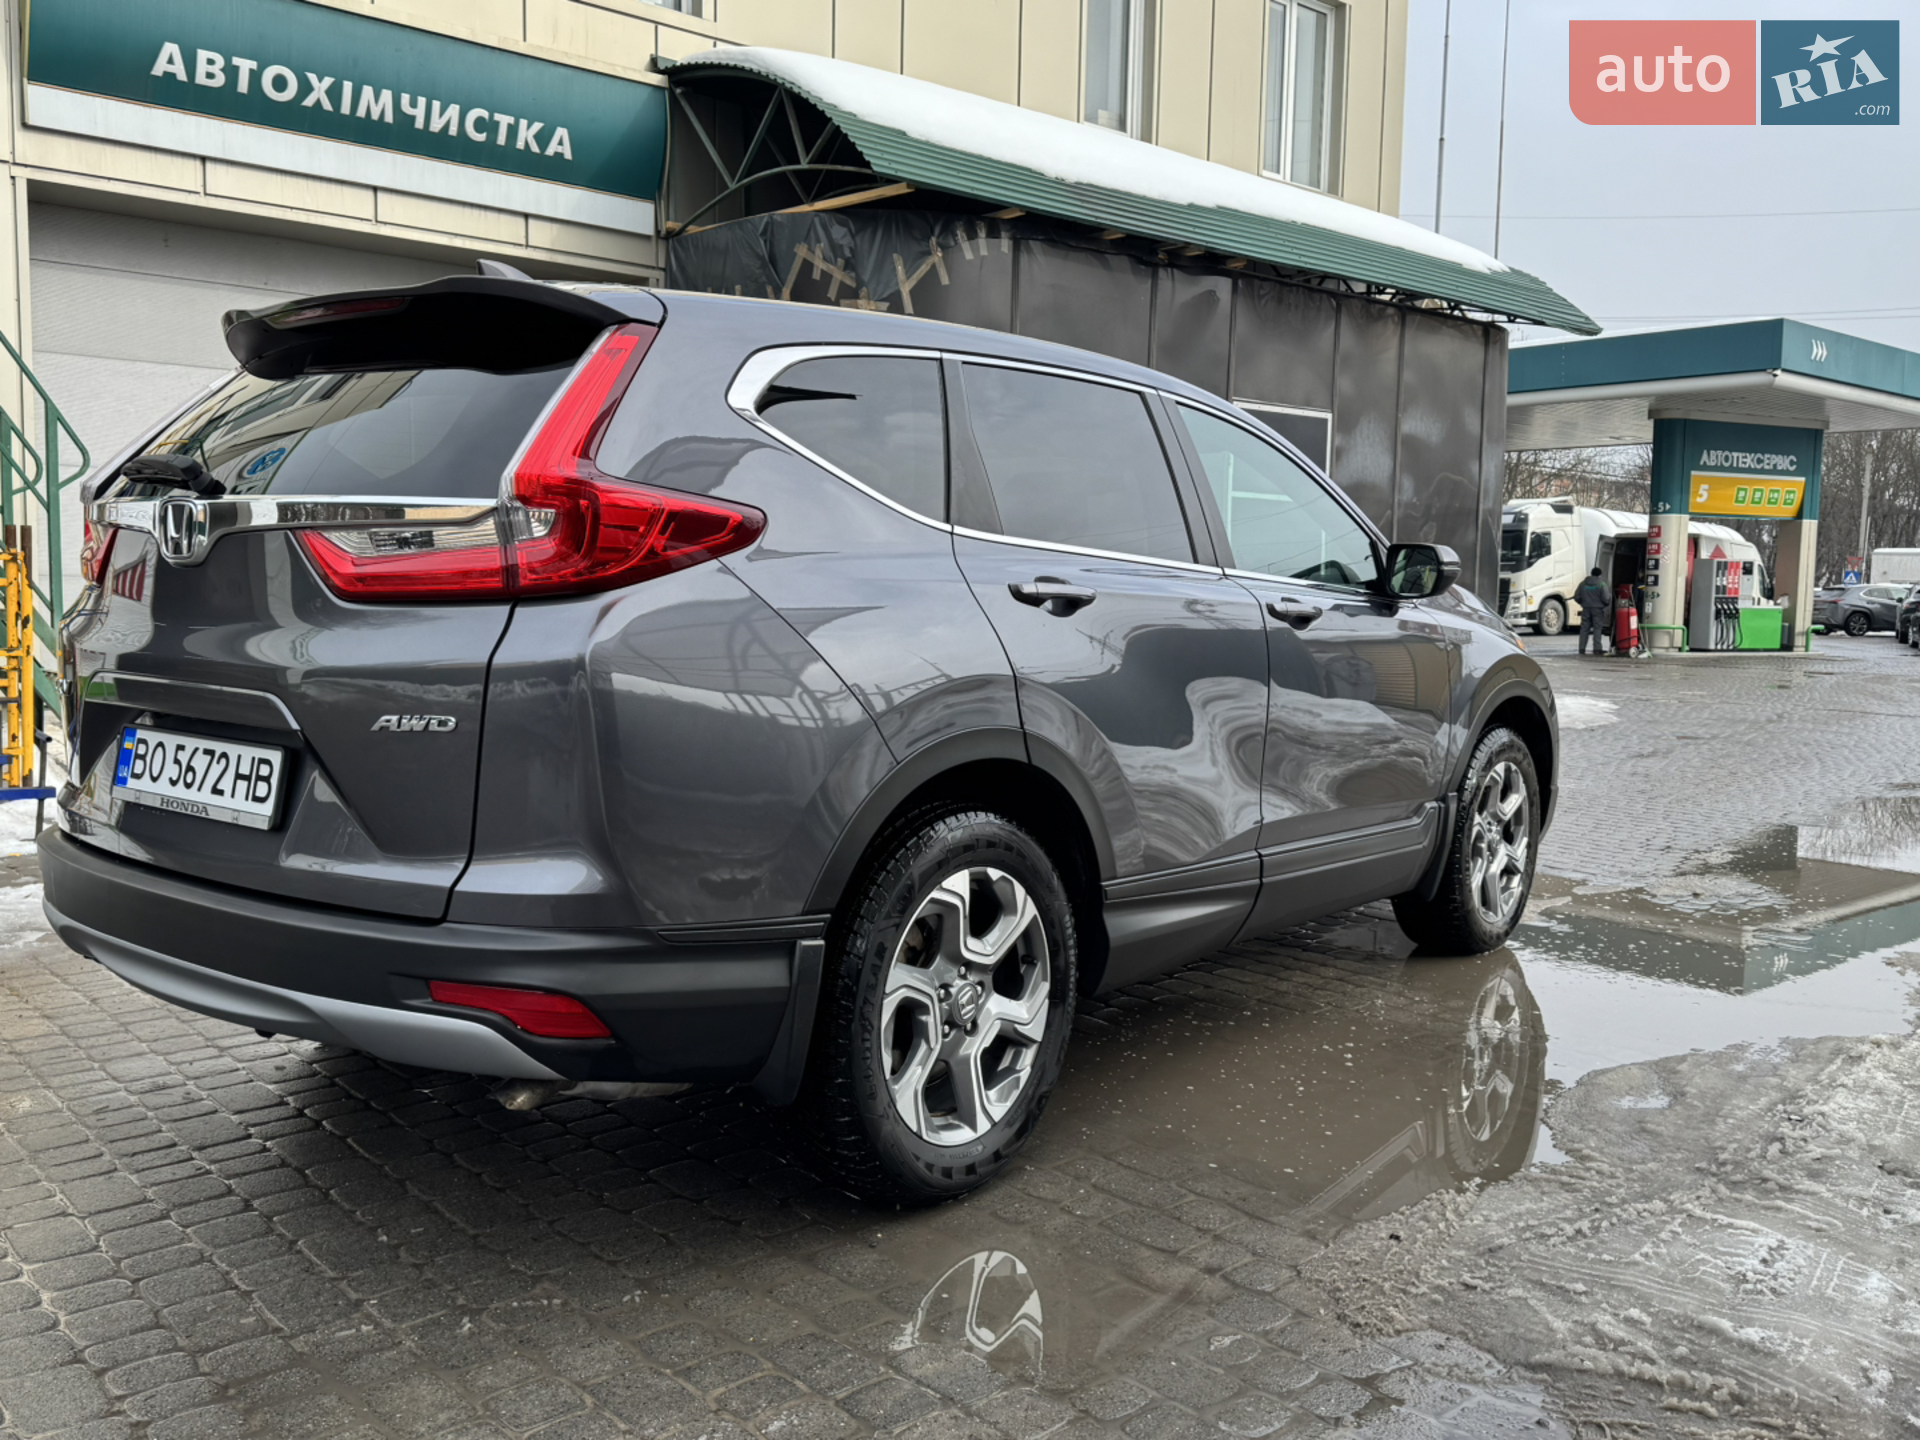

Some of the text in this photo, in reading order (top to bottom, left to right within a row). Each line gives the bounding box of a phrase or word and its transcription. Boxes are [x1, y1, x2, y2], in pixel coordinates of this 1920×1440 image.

[150, 41, 573, 161] АВТОХІМЧИСТКА
[1700, 449, 1797, 471] АВТОТЕХСЕРВІС
[1696, 484, 1709, 503] 5
[370, 715, 458, 732] AWD
[130, 736, 274, 803] BO 5672 HB
[160, 797, 210, 817] HONDA
